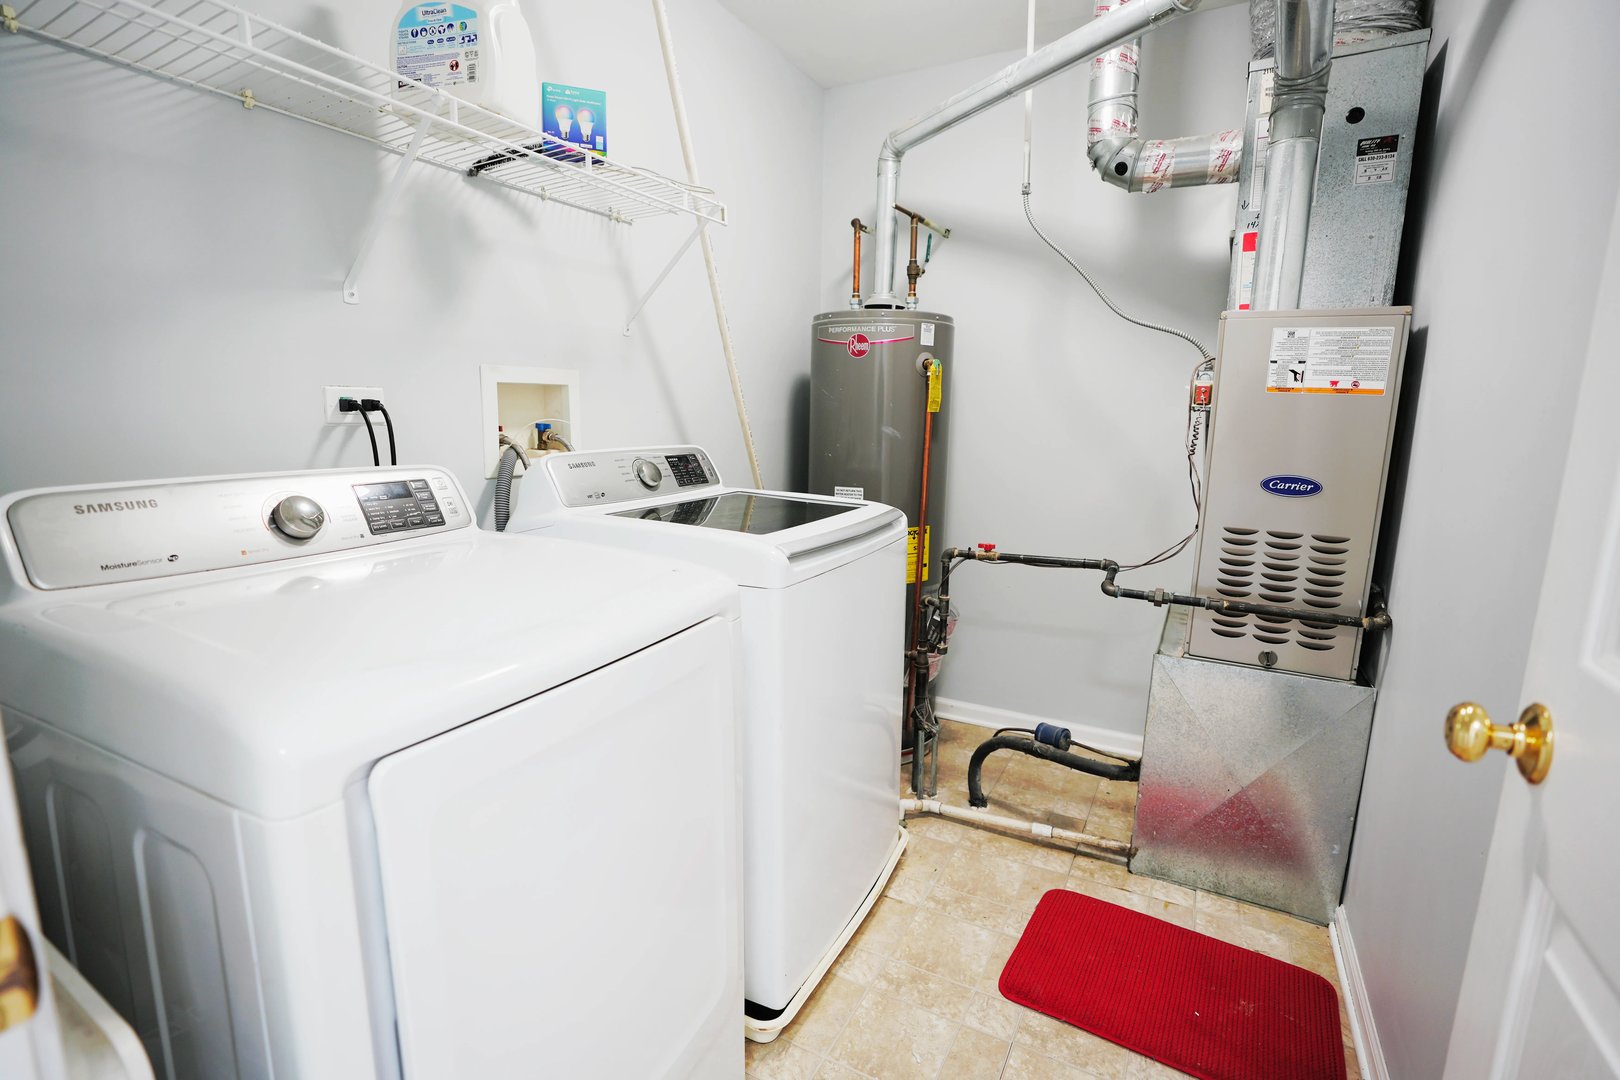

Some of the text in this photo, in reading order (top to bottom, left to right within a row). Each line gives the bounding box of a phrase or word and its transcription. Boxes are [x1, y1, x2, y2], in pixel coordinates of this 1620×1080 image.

[421, 8, 447, 16] UltraClean
[849, 334, 869, 354] Rheem
[568, 461, 596, 470] SAMSUNG
[1269, 480, 1314, 491] Carrier
[73, 499, 158, 515] SAMSUNG
[100, 558, 162, 571] MoistureSensor
